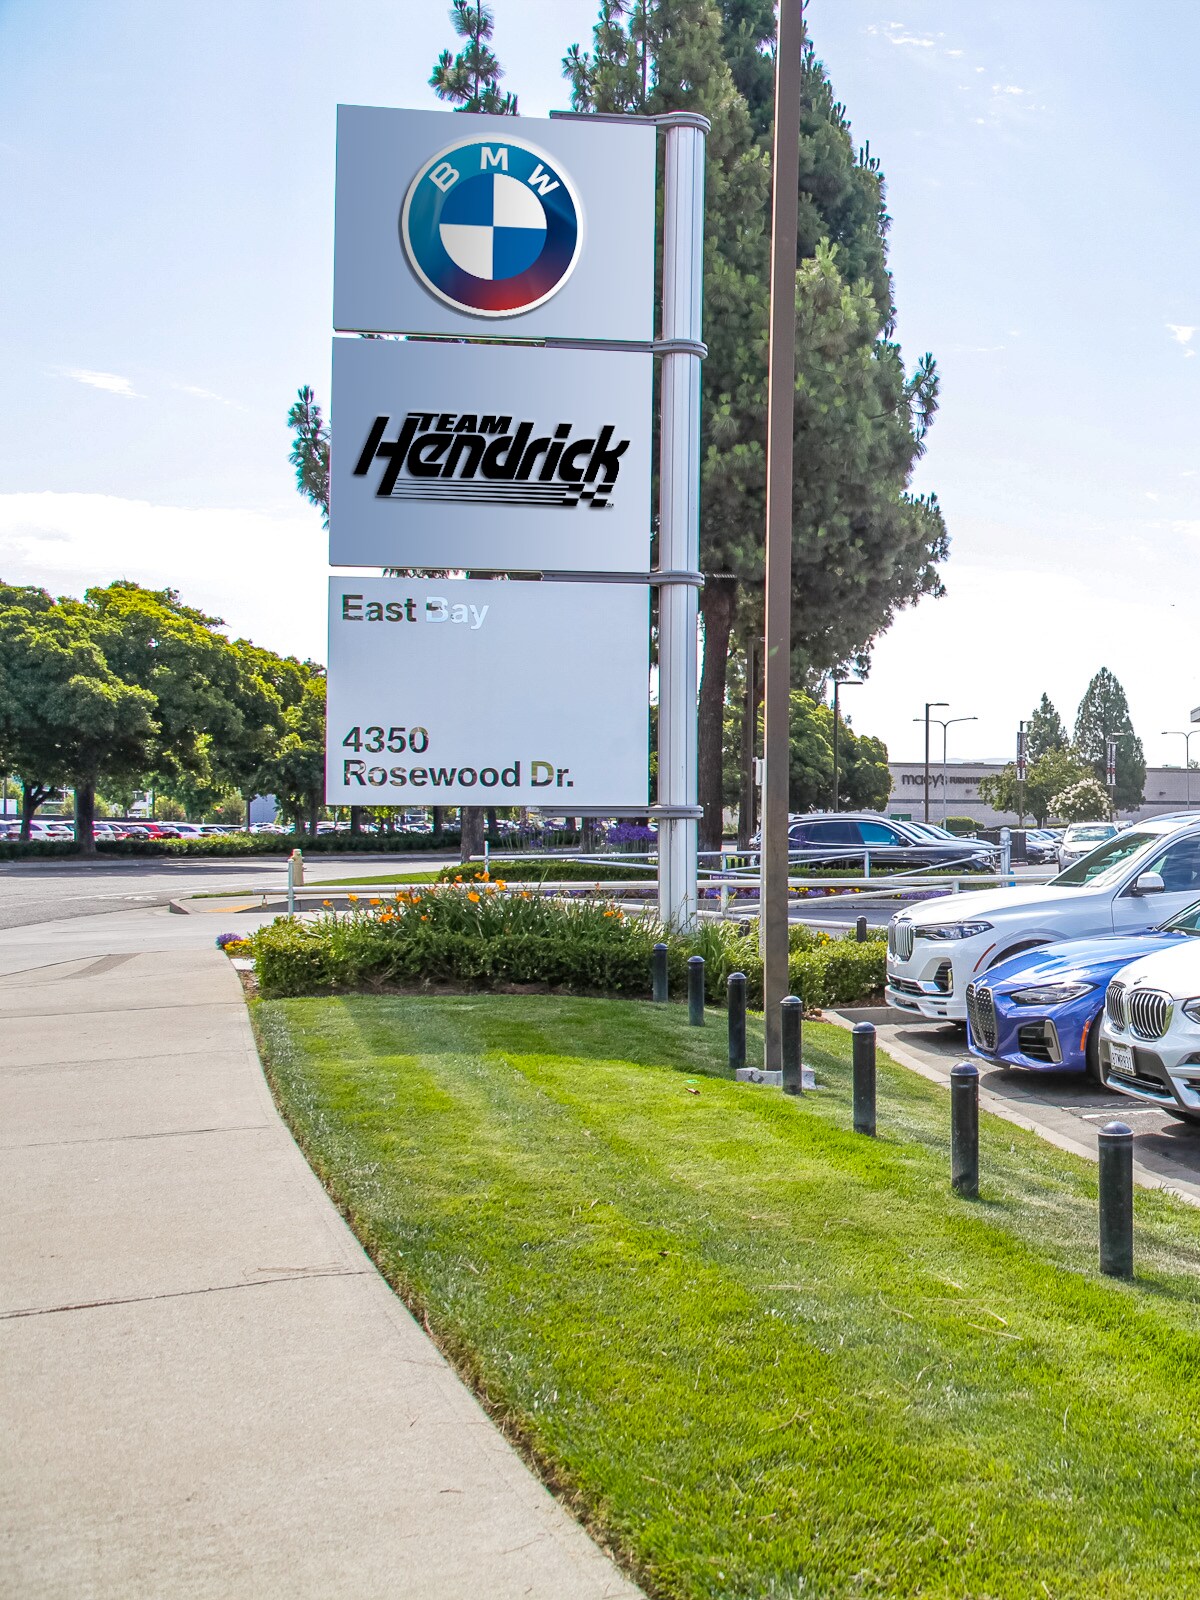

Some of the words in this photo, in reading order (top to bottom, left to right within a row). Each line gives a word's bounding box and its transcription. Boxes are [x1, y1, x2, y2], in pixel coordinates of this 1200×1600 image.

[429, 147, 560, 197] BMW
[407, 412, 513, 434] TEAM
[353, 414, 630, 496] Hendrick
[342, 594, 417, 622] East
[426, 596, 489, 630] Bay
[342, 726, 430, 754] 4350
[343, 759, 521, 787] Rosewood
[531, 761, 574, 787] Dr.
[901, 773, 948, 788] macy's
[949, 776, 982, 785] FURNITUR
